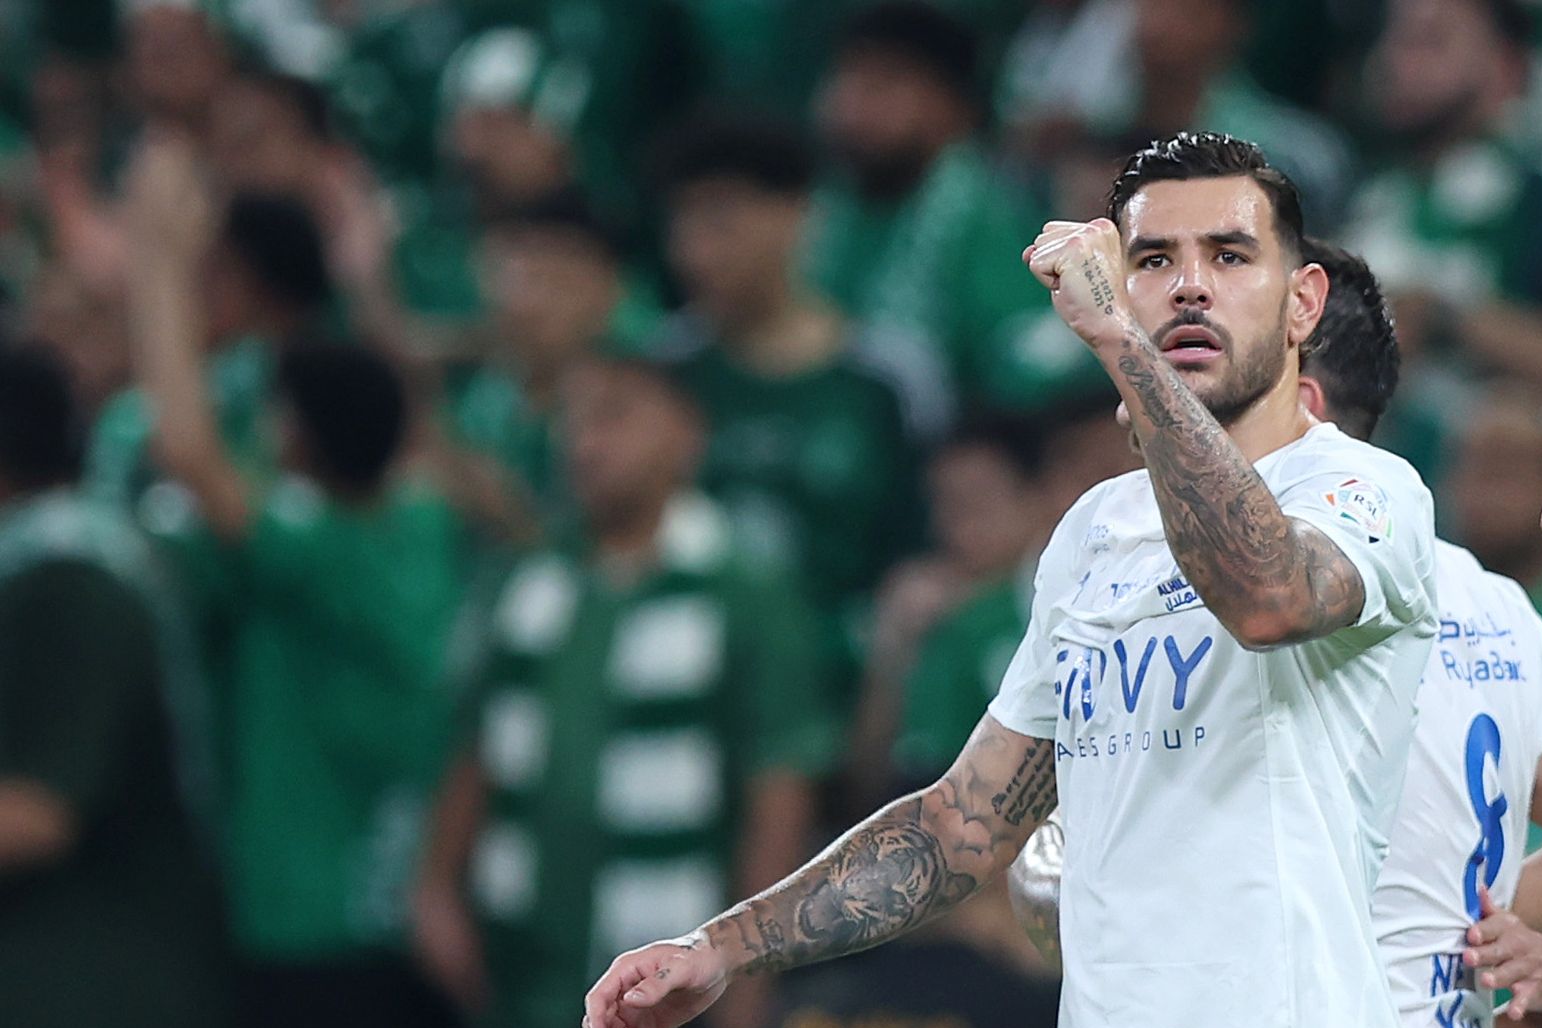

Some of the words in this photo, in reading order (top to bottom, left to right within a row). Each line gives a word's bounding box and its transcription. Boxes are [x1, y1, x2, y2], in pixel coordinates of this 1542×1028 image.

[1157, 578, 1190, 596] ALHIL
[1107, 726, 1206, 756] GROUP
[1464, 713, 1507, 923] 8
